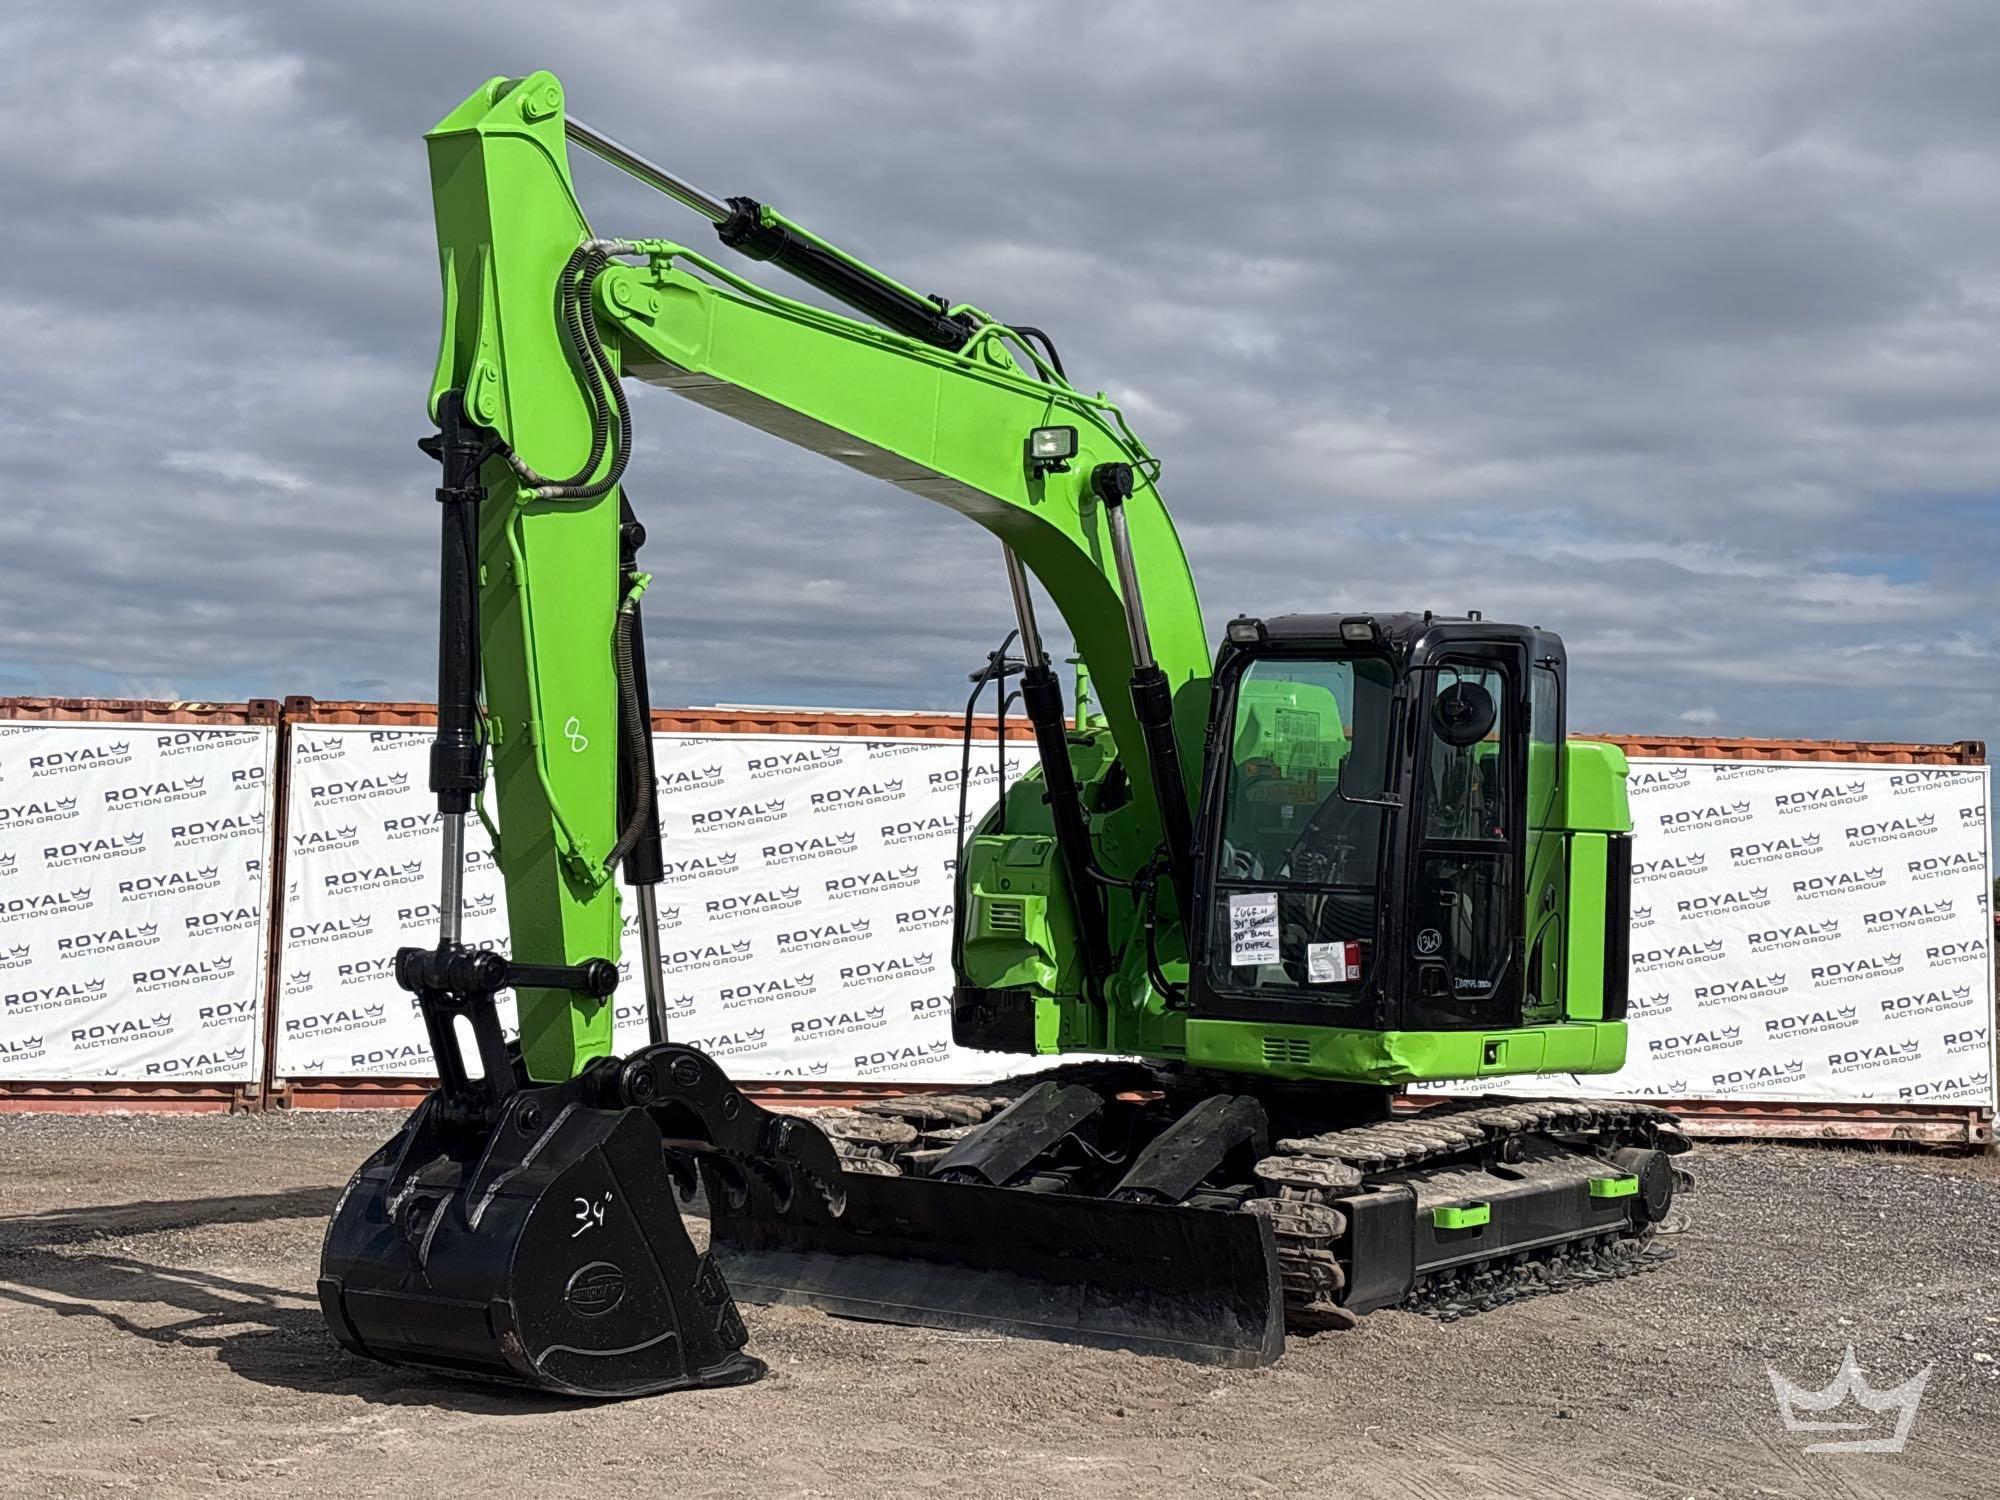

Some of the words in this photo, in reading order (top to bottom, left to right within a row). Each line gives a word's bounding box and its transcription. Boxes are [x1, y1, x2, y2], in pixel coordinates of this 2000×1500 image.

[564, 715, 588, 753] 8
[160, 744, 214, 757] AUCTION
[216, 736, 258, 748] GROUP
[30, 747, 109, 769] ROYAL
[32, 764, 87, 778] AUCTION
[89, 756, 132, 768] GROUP
[304, 751, 346, 764] GROUP
[748, 750, 822, 771] ROYAL
[750, 766, 801, 780] AUCTION
[804, 759, 844, 770] GROUP
[104, 781, 184, 803] ROYAL
[310, 776, 388, 798] ROYAL
[684, 779, 725, 790] GROUP
[810, 784, 885, 805] ROYAL
[1652, 780, 1691, 792] GROUP
[1893, 782, 1942, 796] AUCTION
[1944, 775, 1982, 787] GROUP
[107, 798, 162, 812] AUCTION
[164, 790, 207, 802] GROUP
[313, 794, 366, 808] AUCTION
[368, 786, 411, 799] GROUP
[814, 800, 864, 814] AUCTION
[866, 793, 906, 804] GROUP
[1775, 786, 1847, 806] ROYAL
[1778, 802, 1828, 815] AUCTION
[1830, 794, 1868, 806] GROUP
[692, 804, 766, 825] ROYAL
[694, 820, 745, 834] AUCTION
[748, 813, 788, 824] GROUP
[1660, 805, 1732, 826] ROYAL
[1664, 821, 1712, 834] AUCTION
[1714, 814, 1754, 825] GROUP
[170, 816, 250, 838] ROYAL
[387, 826, 439, 840] AUCTION
[880, 816, 955, 837] ROYAL
[1845, 818, 1917, 838] ROYAL
[1848, 834, 1898, 847] AUCTION
[1900, 826, 1938, 838] GROUP
[44, 838, 123, 860] ROYAL
[173, 832, 228, 847] AUCTION
[318, 840, 360, 852] GROUP
[762, 837, 837, 858] ROYAL
[884, 832, 934, 846] AUCTION
[1730, 838, 1802, 858] ROYAL
[46, 854, 101, 869] AUCTION
[103, 847, 146, 860] GROUP
[766, 853, 816, 866] AUCTION
[818, 846, 858, 858] GROUP
[1734, 854, 1782, 867] AUCTION
[1784, 846, 1824, 858] GROUP
[1908, 852, 1979, 872] ROYAL
[324, 866, 402, 888] ROYAL
[698, 866, 740, 878] GROUP
[824, 870, 899, 891] ROYAL
[1670, 866, 1708, 878] GROUP
[1793, 872, 1865, 892] ROYAL
[1912, 868, 1960, 881] AUCTION
[118, 872, 198, 894] ROYAL
[121, 888, 176, 903] AUCTION
[178, 881, 221, 894] GROUP
[327, 882, 380, 896] AUCTION
[382, 874, 425, 888] GROUP
[828, 886, 878, 900] AUCTION
[880, 879, 920, 890] GROUP
[1796, 888, 1846, 901] AUCTION
[1848, 880, 1886, 892] GROUP
[50, 902, 94, 915] GROUP
[706, 891, 780, 912] ROYAL
[708, 907, 759, 920] AUCTION
[762, 900, 802, 912] GROUP
[1677, 891, 1749, 912] ROYAL
[1680, 907, 1730, 920] AUCTION
[1732, 900, 1770, 911] GROUP
[1863, 904, 1935, 924] ROYAL
[1866, 920, 1916, 933] AUCTION
[1918, 912, 1956, 924] GROUP
[188, 922, 242, 938] AUCTION
[332, 928, 373, 942] GROUP
[776, 924, 851, 945] ROYAL
[899, 919, 949, 933] AUCTION
[1748, 924, 1820, 944] ROYAL
[58, 928, 137, 950] ROYAL
[60, 944, 115, 959] AUCTION
[117, 937, 160, 950] GROUP
[780, 940, 830, 954] AUCTION
[832, 933, 872, 944] GROUP
[1752, 940, 1800, 953] AUCTION
[1802, 932, 1842, 944] GROUP
[712, 954, 753, 966] GROUP
[1632, 944, 1704, 964] ROYAL
[1636, 960, 1684, 973] AUCTION
[1686, 952, 1726, 964] GROUP
[132, 962, 212, 984] ROYAL
[840, 958, 914, 979] ROYAL
[842, 974, 893, 988] AUCTION
[896, 967, 936, 978] GROUP
[1811, 958, 1883, 978] ROYAL
[1814, 974, 1864, 987] AUCTION
[1866, 966, 1904, 978] GROUP
[135, 978, 190, 993] AUCTION
[192, 971, 235, 984] GROUP
[720, 979, 795, 1000] ROYAL
[1695, 978, 1767, 998] ROYAL
[4, 984, 84, 1006] ROYAL
[7, 1000, 62, 1015] AUCTION
[64, 993, 107, 1006] GROUP
[724, 995, 774, 1008] AUCTION
[776, 988, 816, 1000] GROUP
[1698, 994, 1748, 1007] AUCTION
[1750, 986, 1788, 998] GROUP
[1881, 991, 1953, 1012] ROYAL
[1884, 1007, 1934, 1020] AUCTION
[1936, 1000, 1974, 1011] GROUP
[72, 1019, 151, 1041] ROYAL
[286, 1010, 364, 1032] ROYAL
[288, 1026, 342, 1040] AUCTION
[344, 1018, 386, 1032] GROUP
[792, 1012, 866, 1033] ROYAL
[794, 1028, 845, 1042] AUCTION
[848, 1021, 888, 1032] GROUP
[1765, 1011, 1837, 1032] ROYAL
[1768, 1027, 1818, 1040] AUCTION
[1820, 1020, 1858, 1031] GROUP
[74, 1036, 129, 1050] AUCTION
[131, 1028, 174, 1040] GROUP
[1649, 1031, 1721, 1052] ROYAL
[351, 1043, 428, 1066] ROYAL
[854, 1046, 928, 1067] ROYAL
[1652, 1047, 1702, 1060] AUCTION
[1704, 1040, 1742, 1051] GROUP
[1828, 1045, 1900, 1066] ROYAL
[146, 1052, 225, 1075] ROYAL
[206, 1062, 248, 1076] GROUP
[856, 1062, 907, 1076] AUCTION
[910, 1055, 950, 1066] GROUP
[1832, 1061, 1880, 1074] AUCTION
[1882, 1054, 1922, 1065] GROUP
[1712, 1065, 1784, 1086] ROYAL
[1716, 1081, 1764, 1094] AUCTION
[1766, 1074, 1806, 1085] GROUP
[1899, 1077, 1970, 1098] ROYAL
